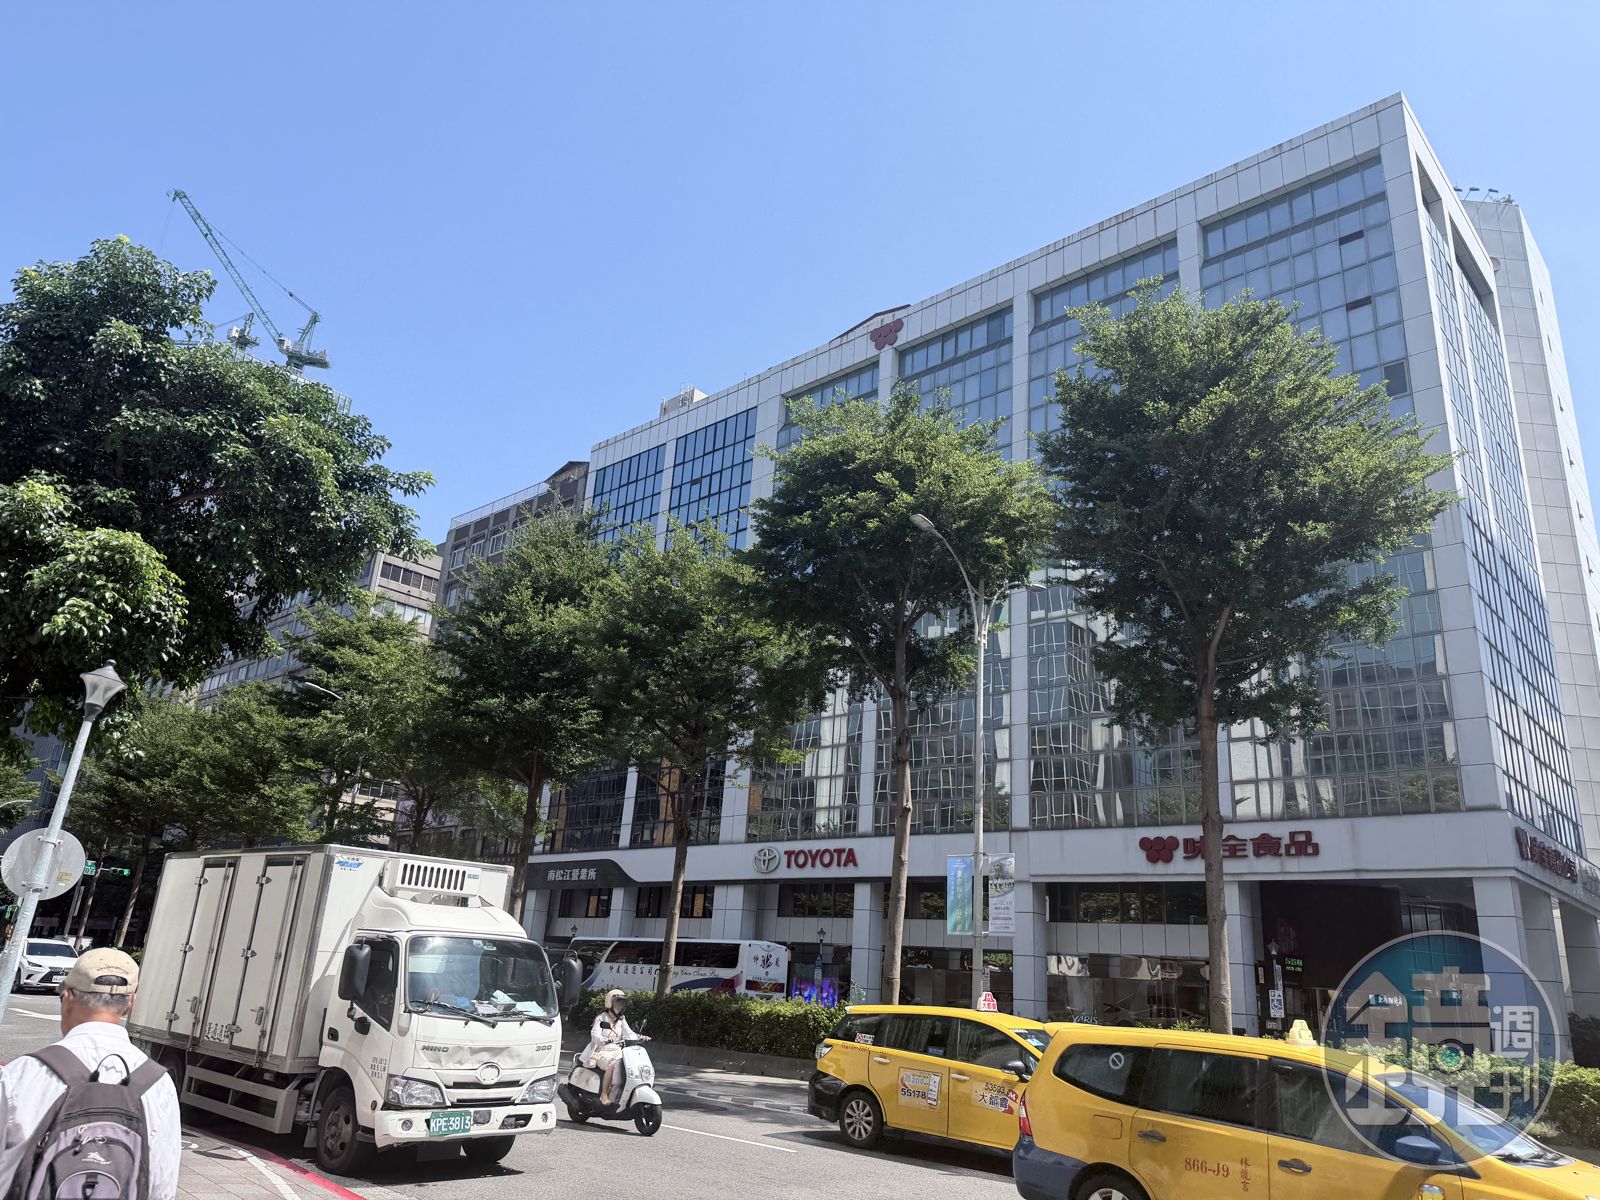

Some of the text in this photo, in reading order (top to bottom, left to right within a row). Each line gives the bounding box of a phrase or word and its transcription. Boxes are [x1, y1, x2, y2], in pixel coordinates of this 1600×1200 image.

[1183, 830, 1320, 861] 味全食品
[783, 848, 858, 869] TOYOTA
[547, 868, 597, 881] 南松江營業所
[421, 1044, 553, 1053] HINO 300
[900, 1087, 927, 1099] 55178
[984, 1083, 1006, 1094] 53593
[978, 1092, 1009, 1109] 大都會
[430, 1114, 472, 1133] KPE-3813
[1184, 1156, 1230, 1178] 866-J9
